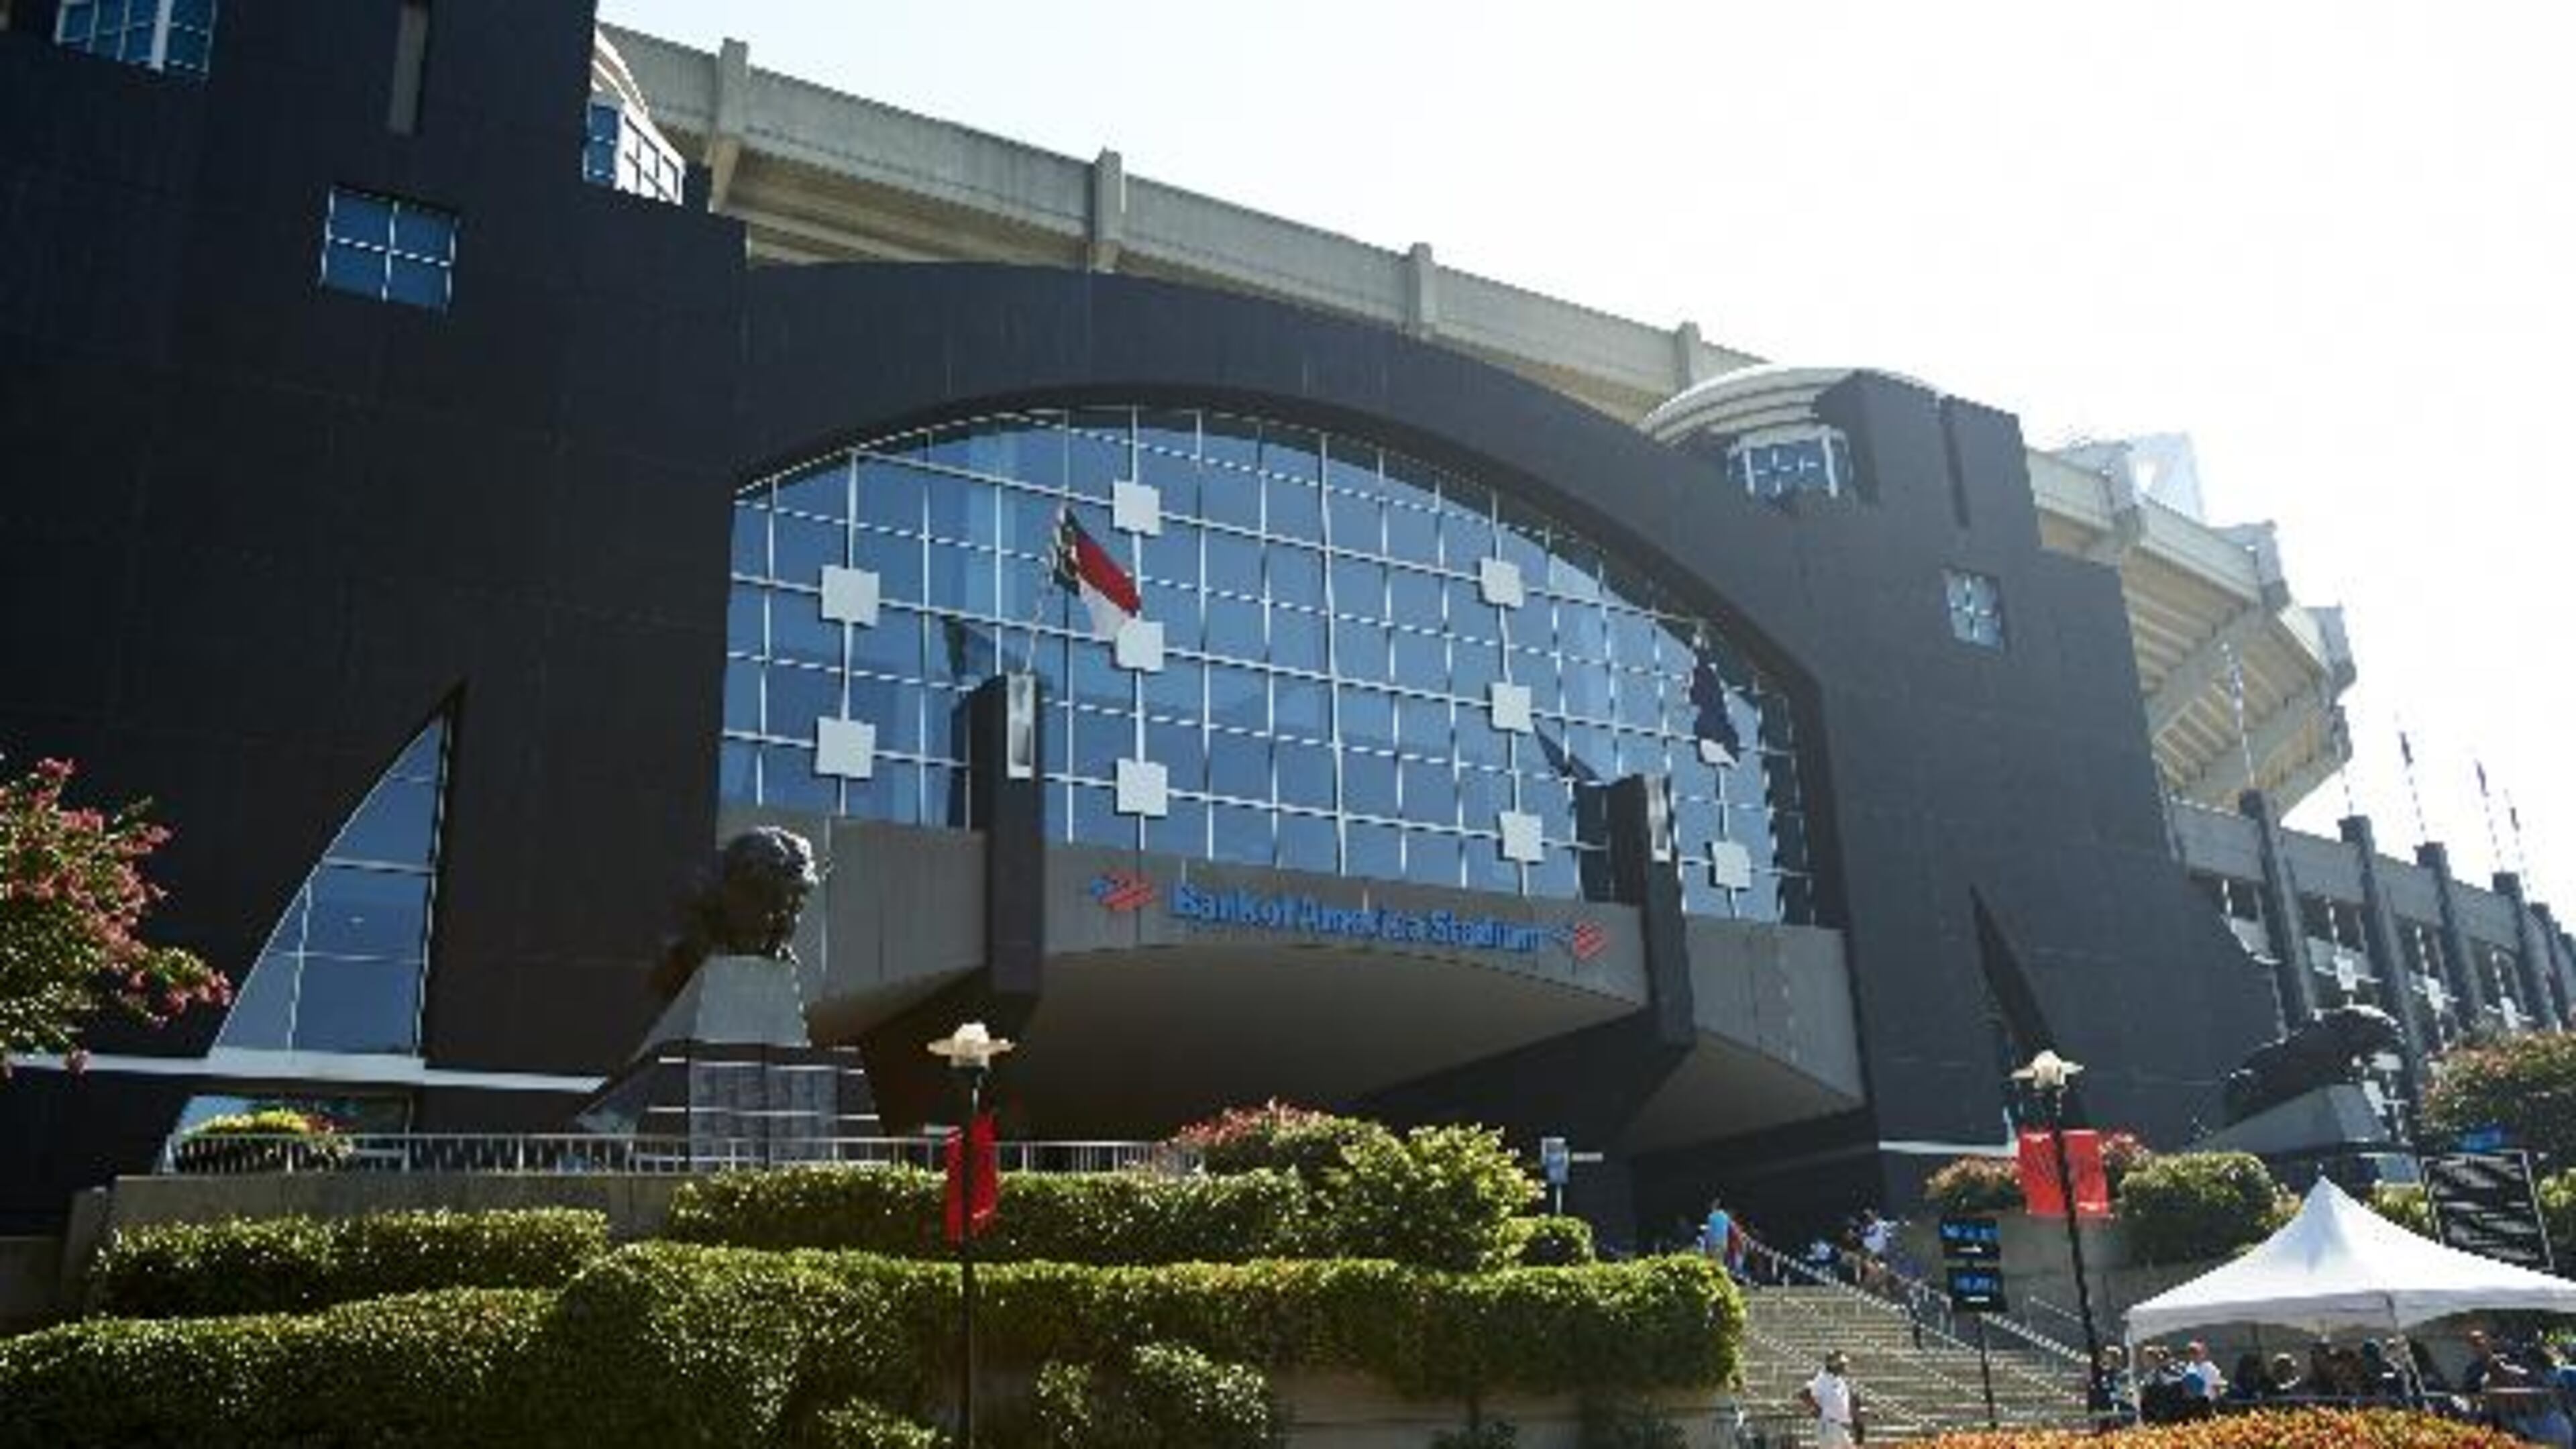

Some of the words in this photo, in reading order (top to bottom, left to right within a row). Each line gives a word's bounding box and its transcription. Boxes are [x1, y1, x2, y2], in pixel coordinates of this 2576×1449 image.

[1171, 883, 1263, 924] Bank
[1263, 896, 1296, 927] of
[1299, 898, 1428, 938] America
[1430, 909, 1544, 951] Stadium
